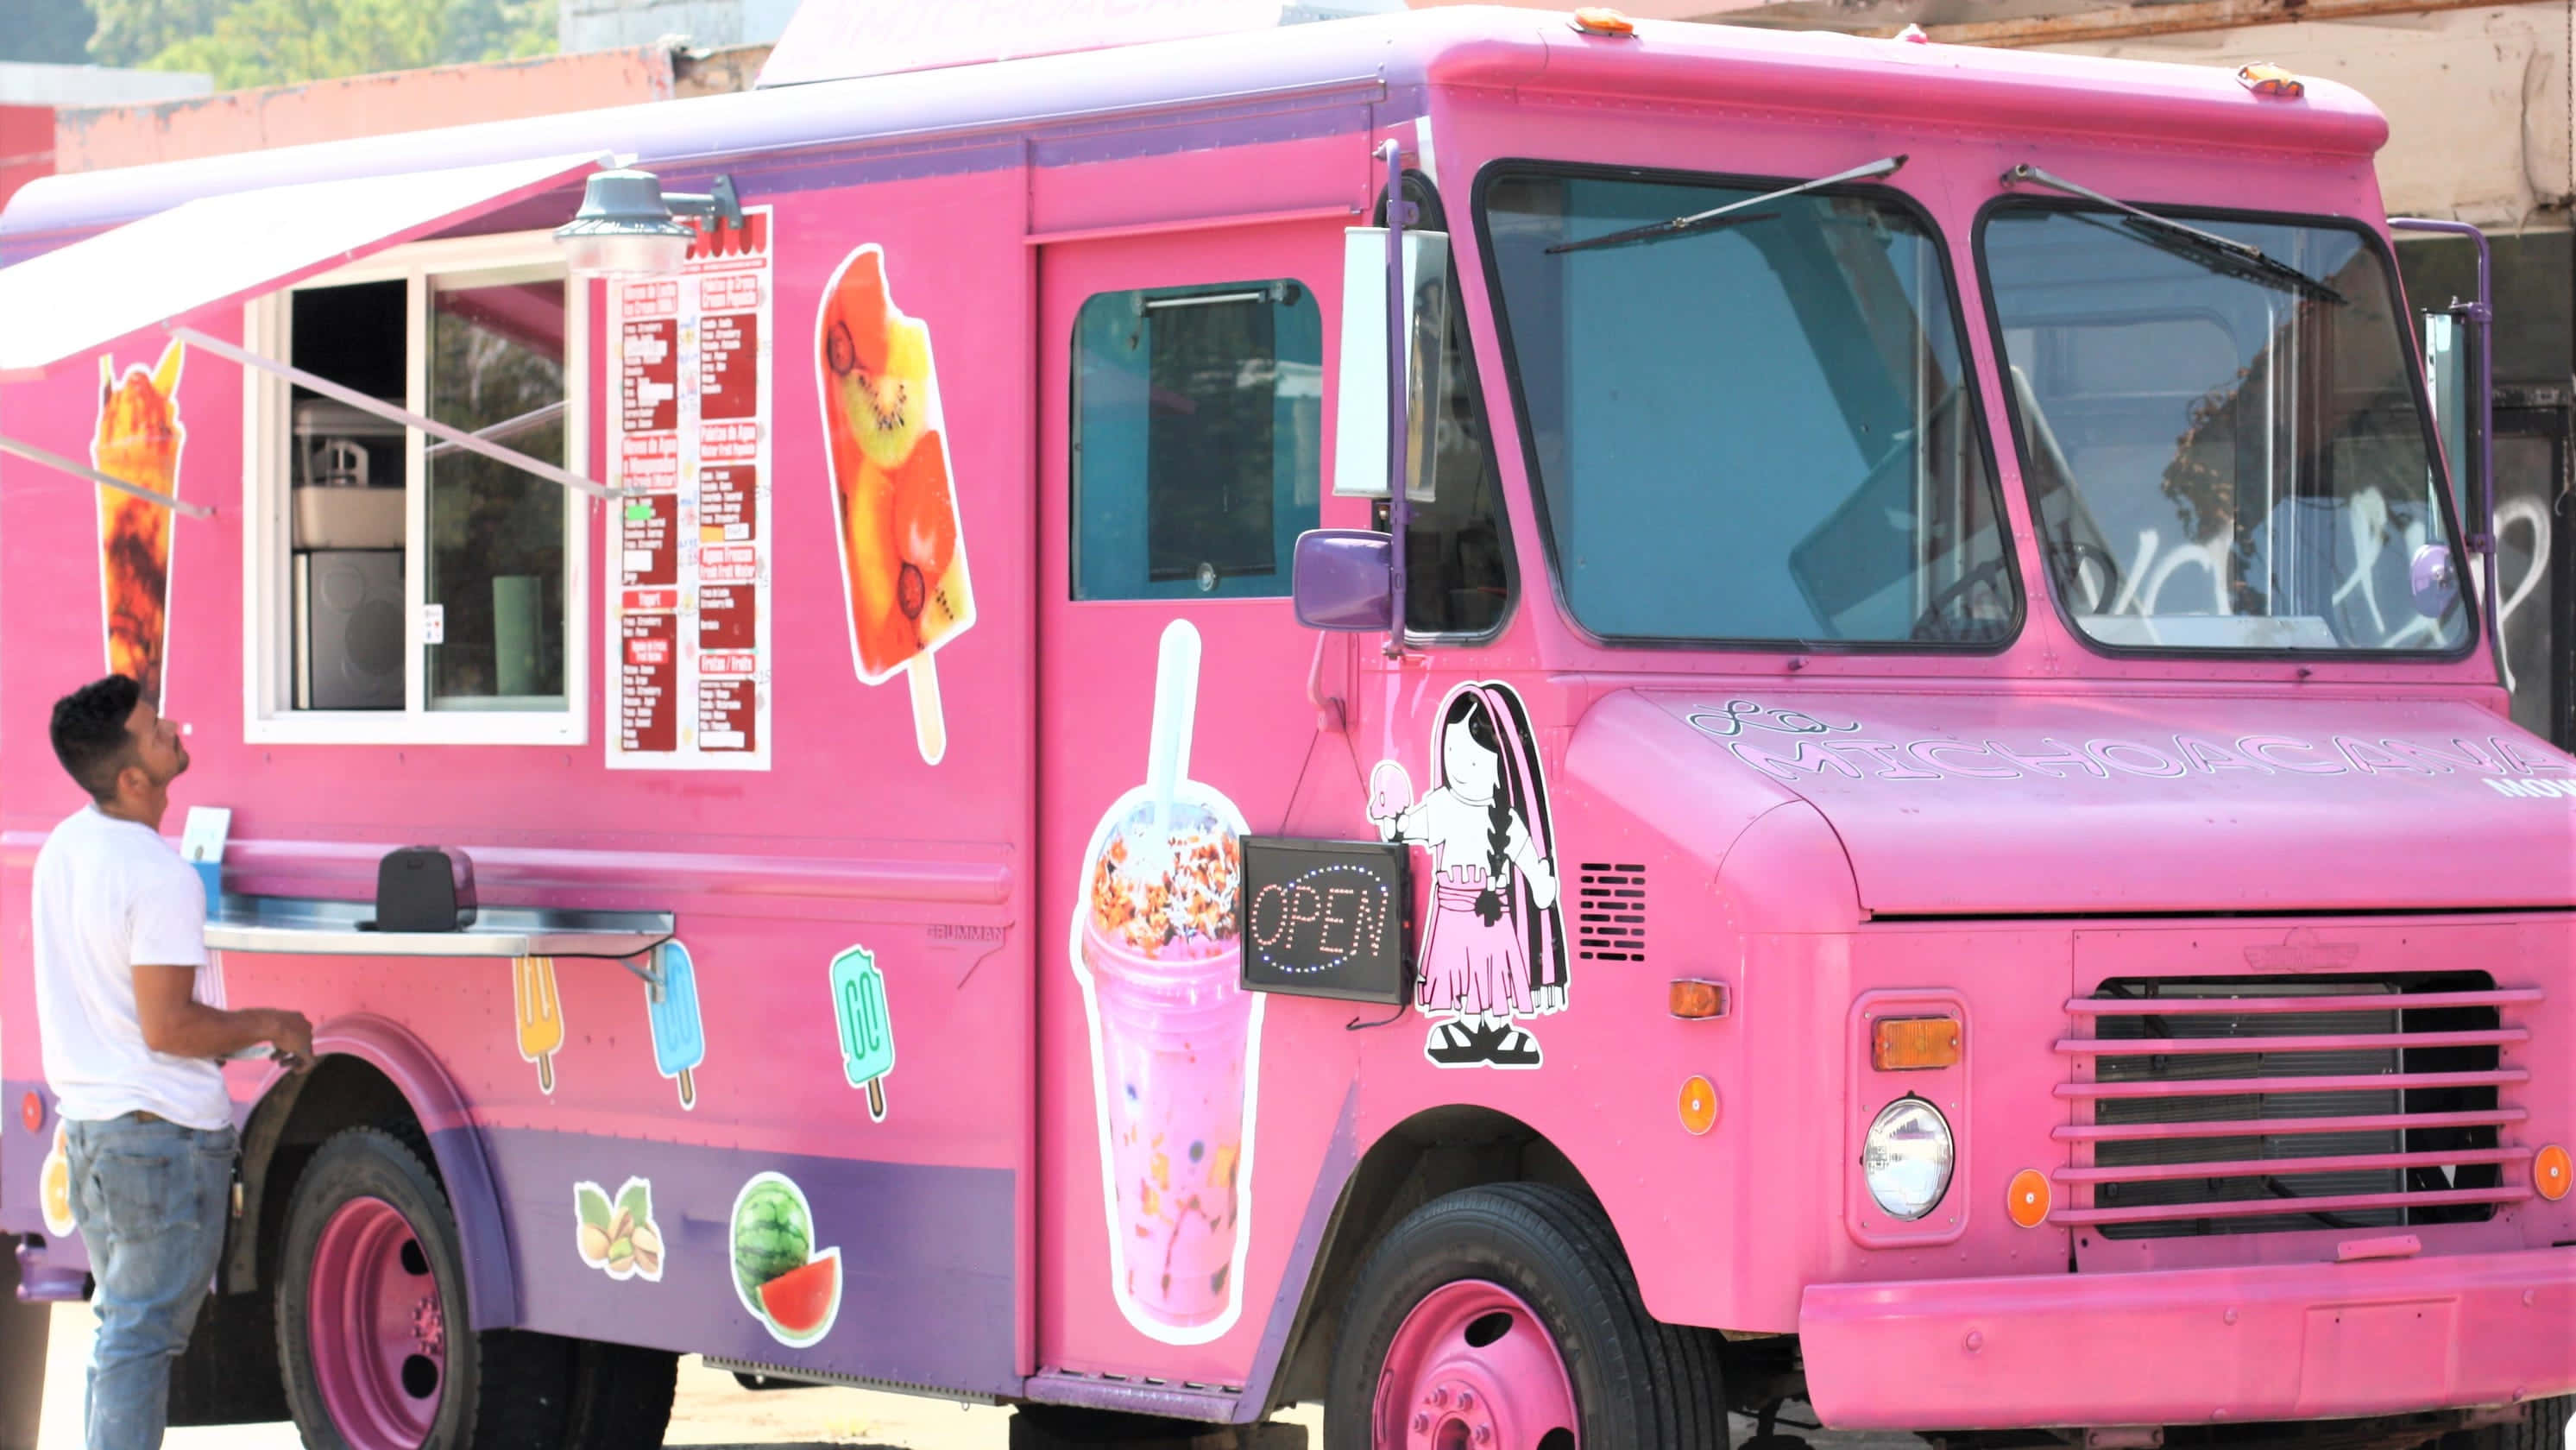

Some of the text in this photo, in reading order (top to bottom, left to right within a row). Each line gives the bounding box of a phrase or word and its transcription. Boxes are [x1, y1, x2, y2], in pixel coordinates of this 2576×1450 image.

[1685, 699, 1862, 735] La
[1729, 733, 2576, 781] MICHOACANA
[1250, 883, 1389, 957] OPEN
